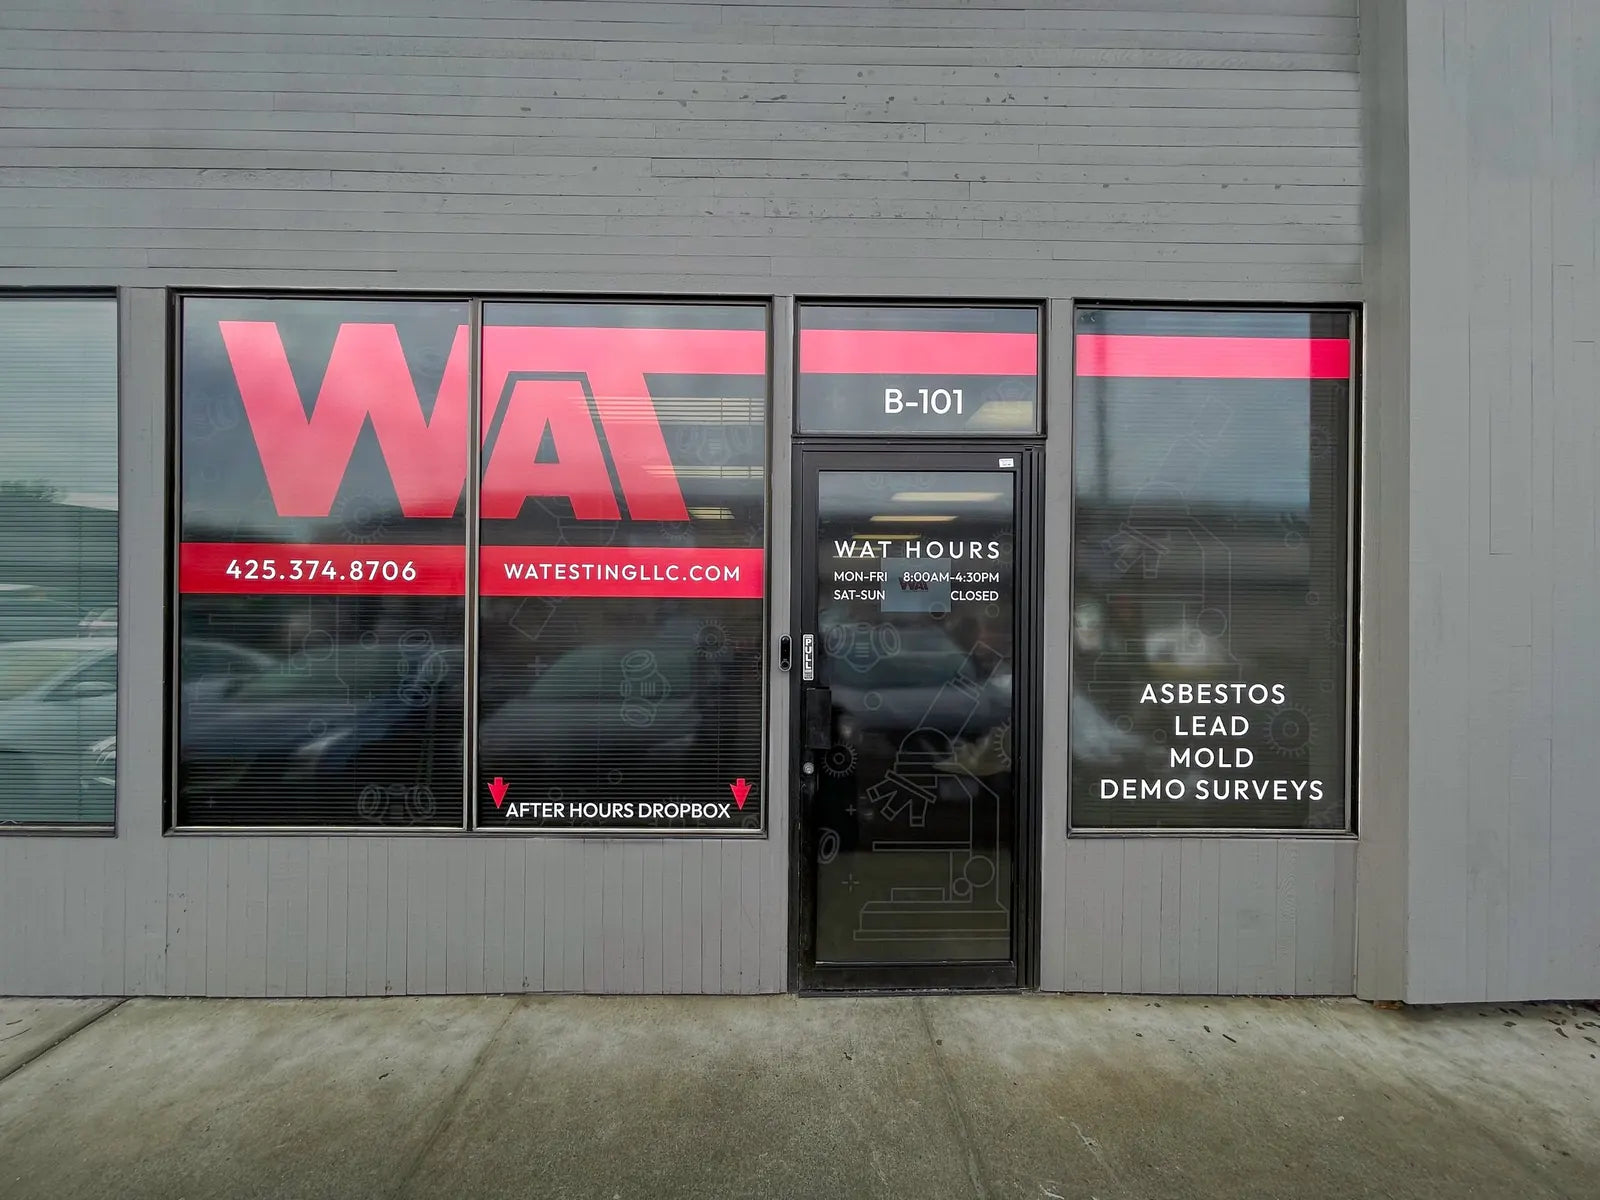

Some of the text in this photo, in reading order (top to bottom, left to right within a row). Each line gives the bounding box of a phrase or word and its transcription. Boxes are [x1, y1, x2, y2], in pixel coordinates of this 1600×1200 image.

[883, 388, 964, 415] B-101
[218, 320, 692, 521] WAT
[833, 540, 1001, 560] WAT HOURS
[226, 559, 417, 582] 425.374.8706
[503, 563, 741, 582] WATESTINGLLC.COM
[833, 571, 1000, 584] MON-FRI 8:00AM-4:30PM
[833, 589, 999, 602] SAT-SUN CLOSED
[1139, 683, 1286, 705] ASBESTOS
[1175, 715, 1249, 736] LEAD
[1170, 747, 1254, 768] MOLD
[1100, 779, 1324, 801] DEMO SURVEYS
[505, 802, 731, 819] AFTER HOURS DROPBOX
